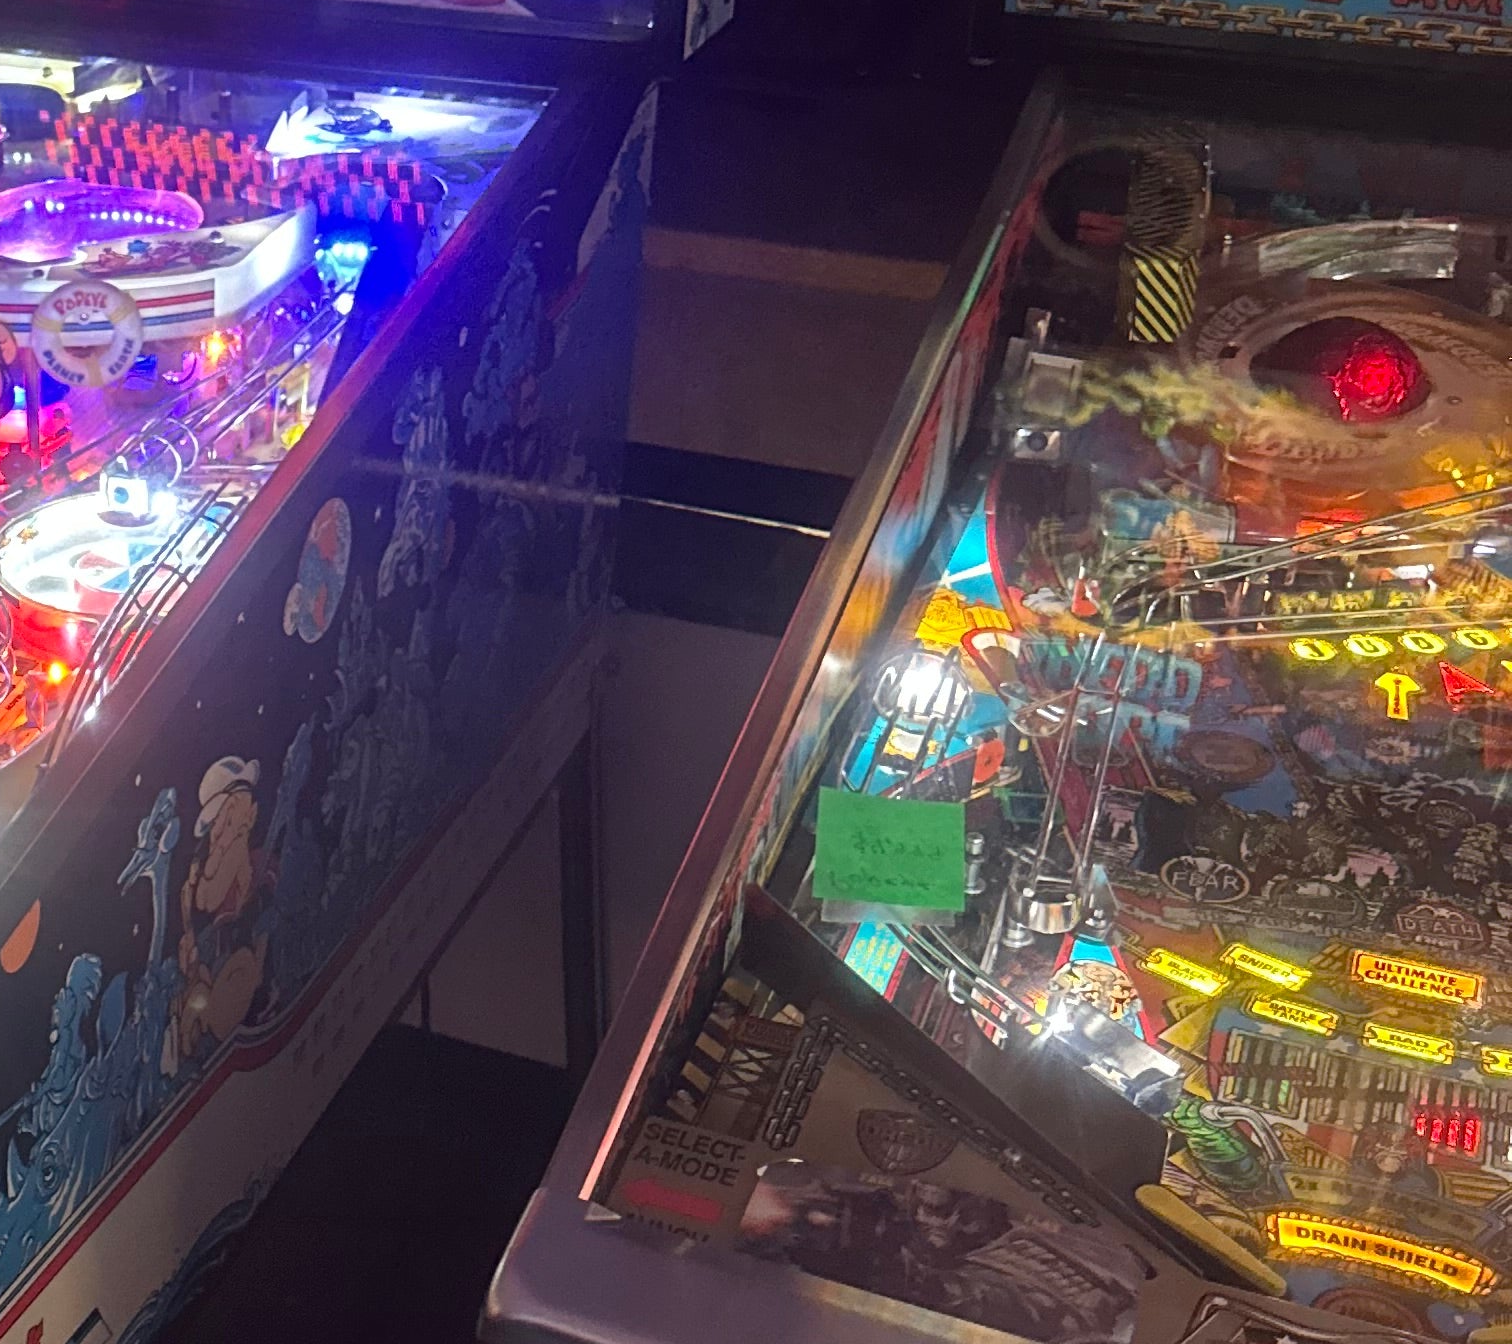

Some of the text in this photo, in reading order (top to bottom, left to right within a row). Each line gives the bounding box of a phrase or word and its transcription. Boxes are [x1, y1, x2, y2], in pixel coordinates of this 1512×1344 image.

[53, 288, 108, 318] POPEYE
[1171, 871, 1240, 892] FEAR
[1403, 918, 1475, 937] DEATH
[1167, 960, 1207, 982] BLACK
[1237, 953, 1291, 978] SNIPER
[1373, 960, 1458, 987] ULTIMATE
[1364, 969, 1465, 999] CHALLENGE
[1268, 1002, 1318, 1021] BATTLE
[1271, 1009, 1309, 1025] TANK
[1389, 1034, 1430, 1049] BAD
[643, 1122, 747, 1163] SELECT-
[632, 1143, 741, 1187] A-MODE
[1295, 1226, 1458, 1277] DRAIN SHIELD
